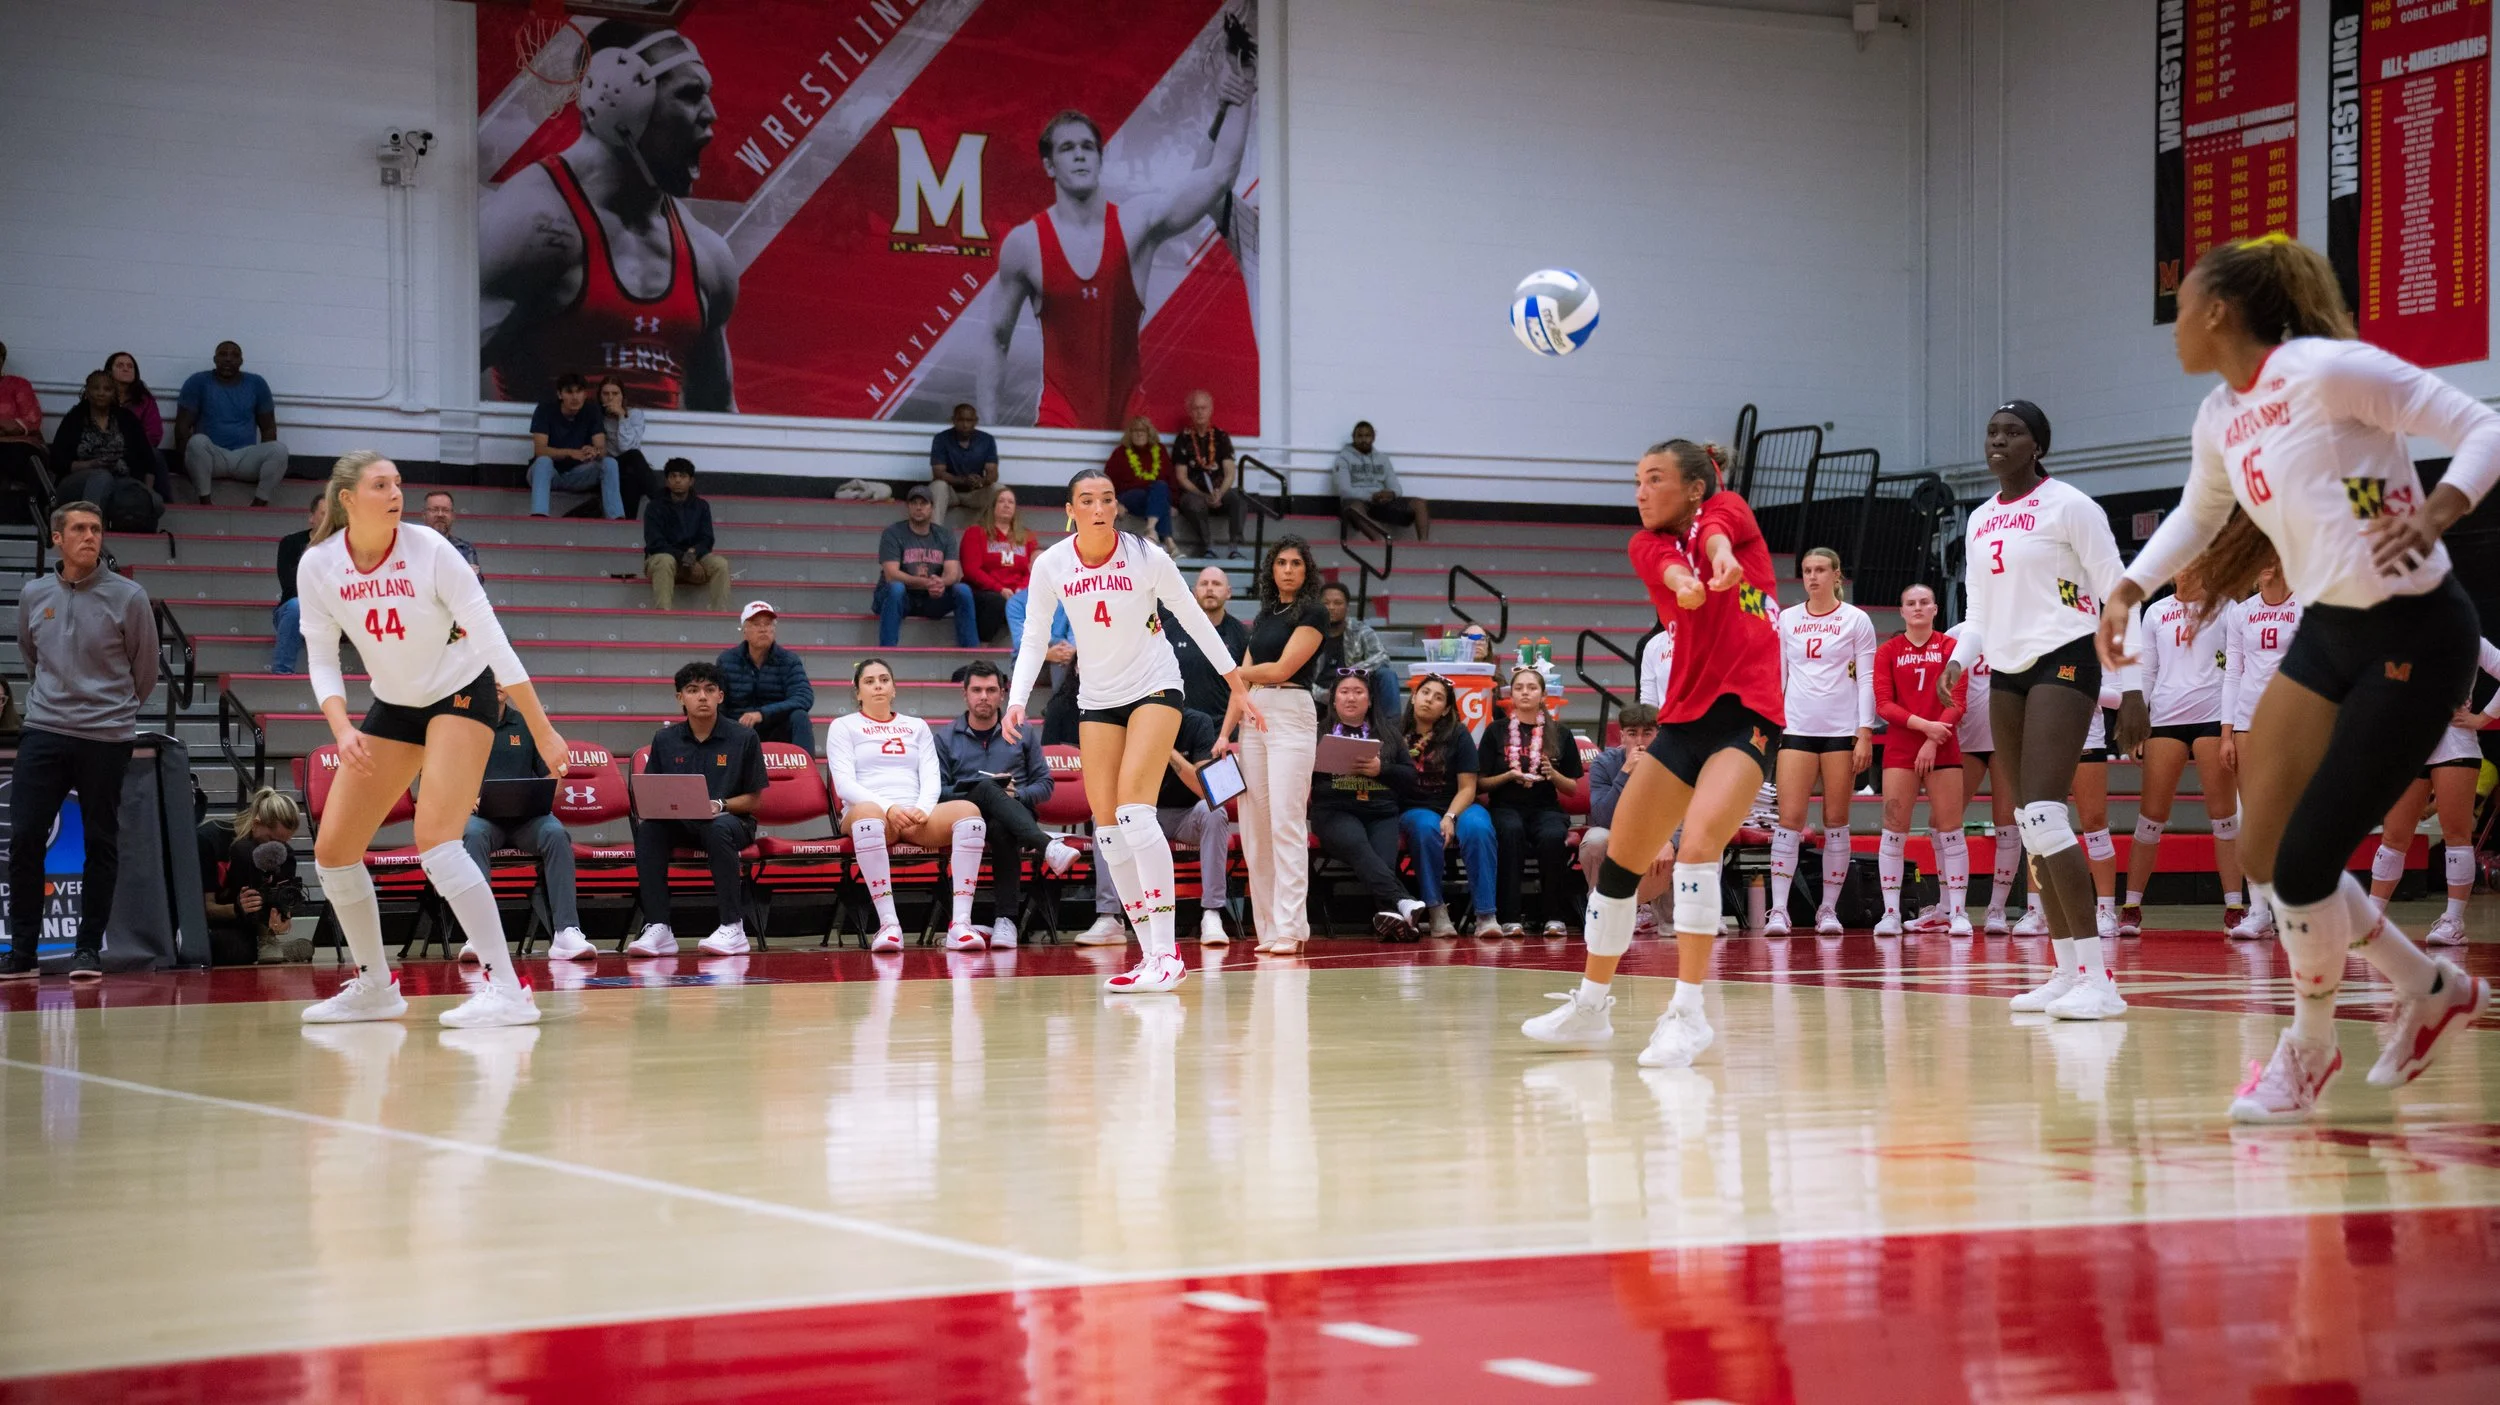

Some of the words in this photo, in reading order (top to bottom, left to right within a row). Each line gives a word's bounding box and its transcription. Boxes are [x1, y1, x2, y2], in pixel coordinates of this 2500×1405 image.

[2371, 16, 2391, 31] 1969
[2400, 7, 2429, 24] GOBEL
[2431, 1, 2458, 16] KLINE
[2381, 35, 2487, 80] ALL-AMERICANS
[734, 0, 921, 176] WRESTLIN
[2159, 0, 2184, 154] WRESTLIN
[2332, 14, 2359, 200] WRESTLING
[2269, 148, 2286, 161] 1971
[2268, 164, 2286, 177] 1972
[891, 126, 990, 240] M
[2268, 180, 2287, 193] 1973
[2159, 259, 2180, 294] M
[866, 272, 979, 402] MARYLAND
[2242, 446, 2272, 507] 16
[1973, 513, 2036, 542] MARYLAND
[1001, 551, 1014, 566] M
[1989, 539, 2005, 575] 3
[340, 578, 416, 602] MARYLAND
[1063, 575, 1133, 598] MARYLAND
[365, 608, 406, 642] 44
[1094, 600, 1112, 628] 4
[2248, 612, 2295, 625] MARYLAND
[1793, 623, 1841, 636] MARYLAND
[2175, 625, 2194, 649] 14
[2261, 627, 2278, 650] 19
[1806, 637, 1823, 659] 12
[1896, 651, 1942, 668] MARYLAND
[1914, 668, 1926, 691] 7
[453, 694, 472, 710] M
[1462, 692, 1483, 719] G
[862, 725, 914, 736] MARYLAND
[568, 750, 608, 764] YLAND
[881, 737, 906, 755] 23
[763, 753, 808, 767] RYLAND
[1046, 756, 1081, 769] RYLAN
[375, 855, 421, 865] UMTERPS.CO
[792, 844, 841, 855] UMTERPS.COM
[893, 846, 940, 855] UMTERPS.COM
